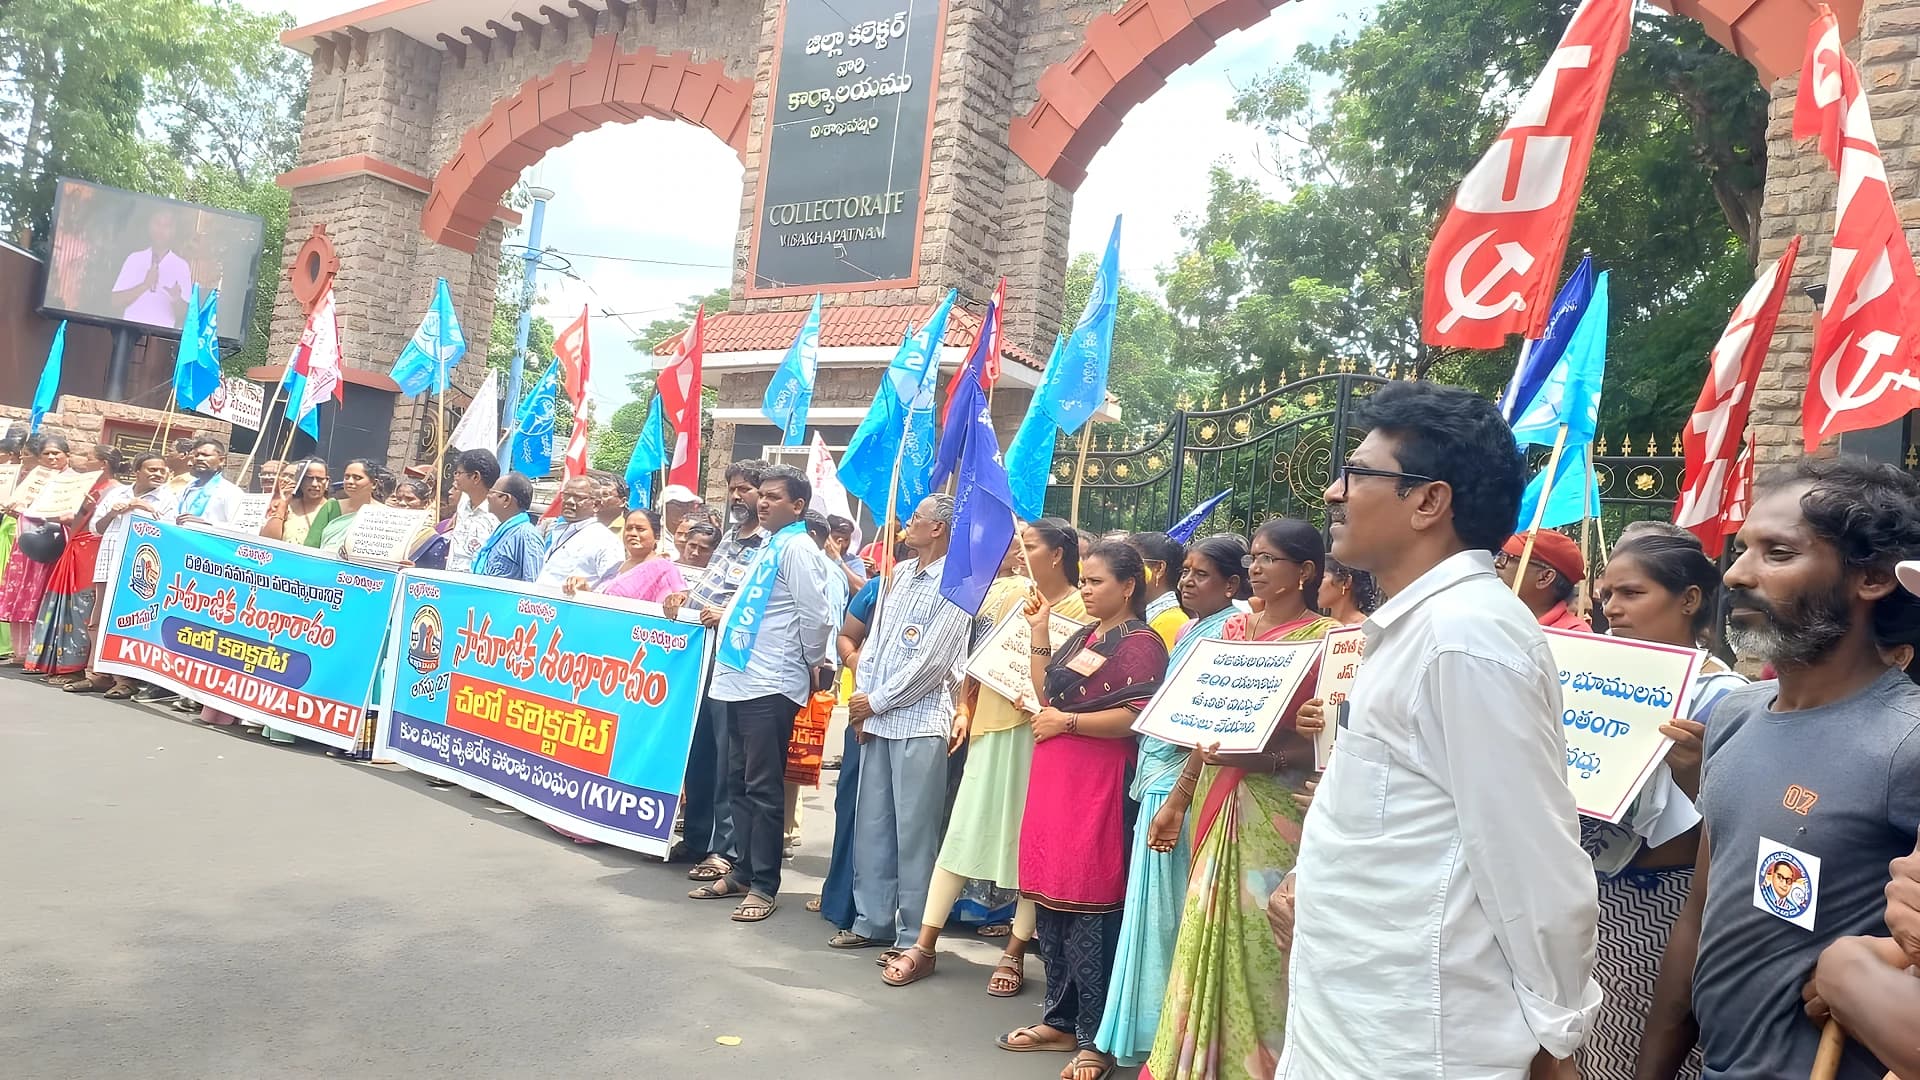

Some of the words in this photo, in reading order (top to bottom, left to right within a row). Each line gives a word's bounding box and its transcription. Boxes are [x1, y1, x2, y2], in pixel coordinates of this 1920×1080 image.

[806, 31, 844, 57] జిల్లా
[848, 11, 907, 49] కలెక్టర్
[837, 58, 864, 77] వారి
[788, 73, 912, 114] కార్యాలయము
[810, 117, 878, 138] విశాఖపట్నం
[769, 192, 904, 225] COLLECTORATE
[780, 226, 886, 246] VISAKHAPATNAM
[224, 565, 270, 591] సమస్యలు
[164, 573, 237, 624] సామాజిక
[239, 593, 335, 647] శంఖారావం
[177, 627, 217, 651] చలో
[217, 637, 290, 674] కలెక్టరేట్
[453, 607, 537, 680] సామాజిక
[539, 627, 667, 706] శంఖారావం
[118, 638, 358, 733] KVPS-CITU-AIDWA-DYFI
[437, 673, 449, 691] 27
[1572, 672, 1673, 708] భూములను
[455, 684, 505, 721] చలో
[506, 700, 612, 756] కలెక్టరేట్
[1562, 709, 1631, 738] ంతంగా
[400, 721, 419, 741] కుల
[421, 728, 451, 762] వివక్ష
[452, 737, 490, 766] వ్యతిరేక
[491, 749, 530, 780] పోరాట
[532, 765, 579, 799] సంఘం
[581, 781, 665, 829] (KVPS)
